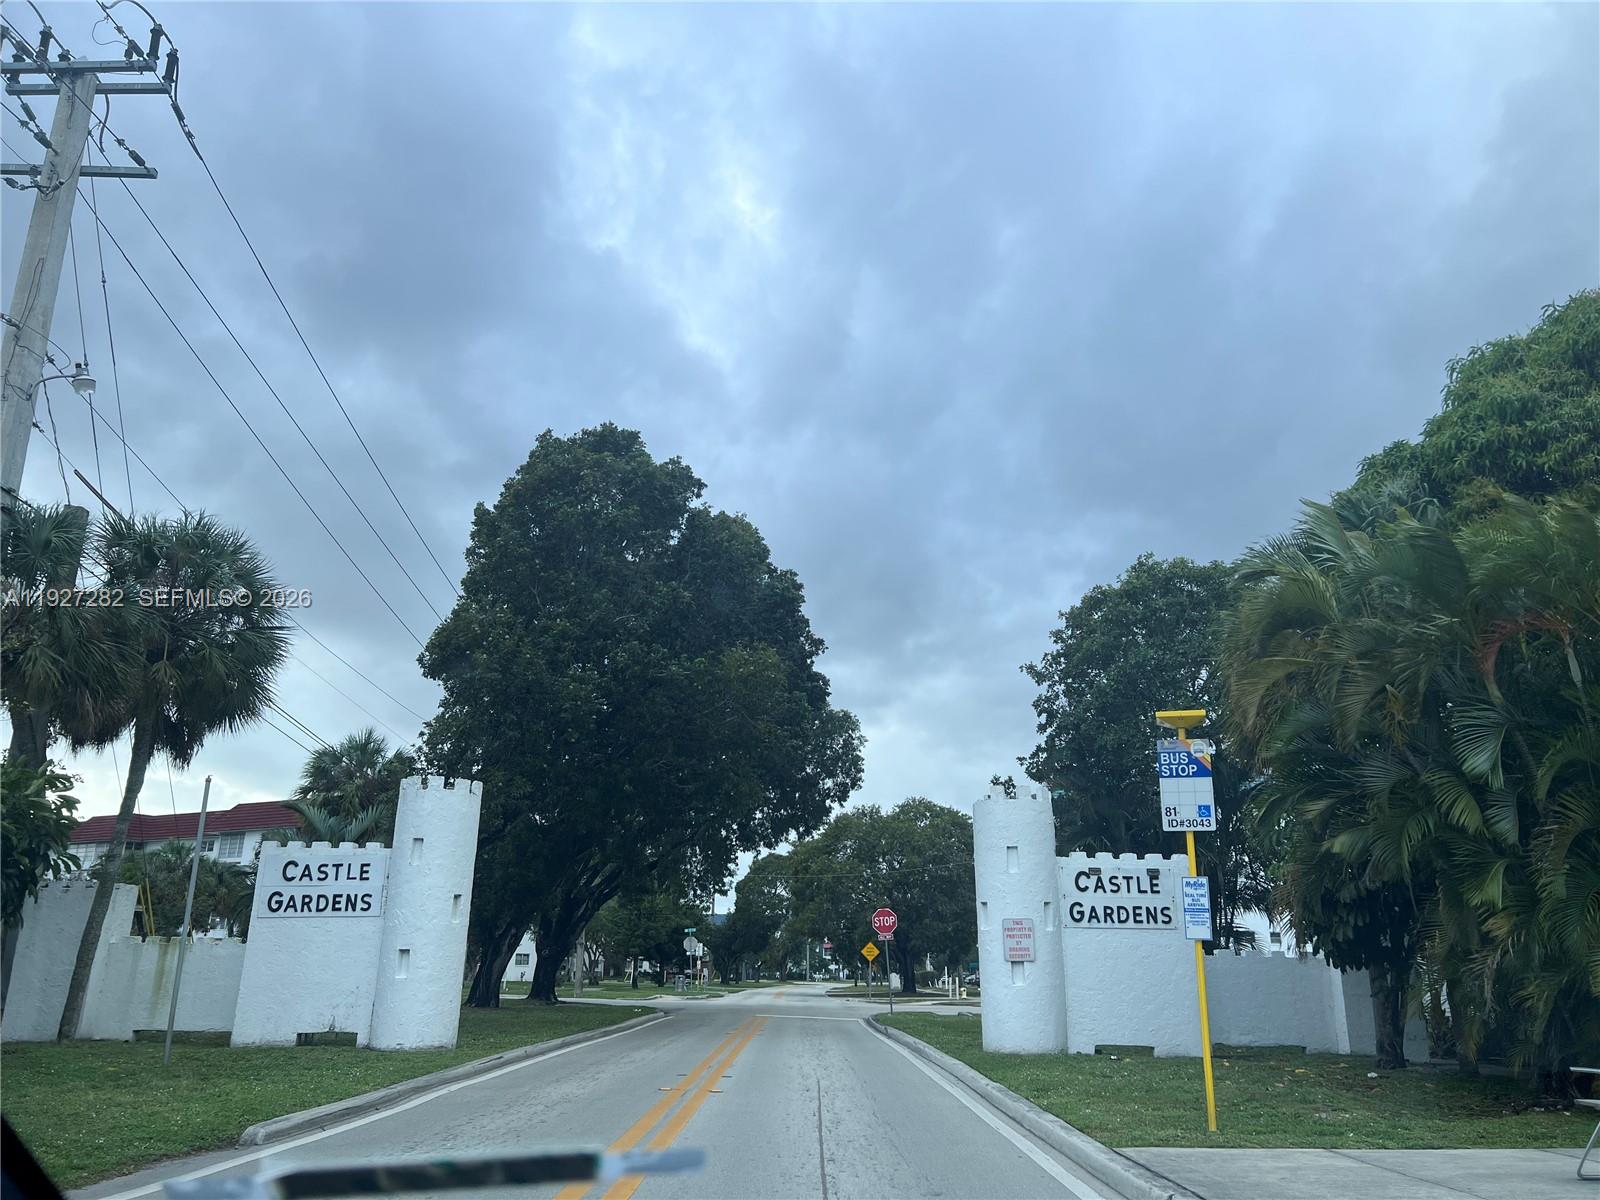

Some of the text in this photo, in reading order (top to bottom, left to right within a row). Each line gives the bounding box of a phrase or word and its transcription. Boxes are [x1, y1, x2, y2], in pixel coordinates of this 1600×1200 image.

[1161, 752, 1189, 764] BUS
[1161, 764, 1197, 777] STOP
[1165, 806, 1177, 817] 81
[1168, 819, 1212, 828] ID#3043
[282, 860, 371, 882] CASTLE
[1075, 870, 1161, 894] CASTLE
[268, 891, 373, 913] GARDENS
[1069, 902, 1172, 924] GARDENS
[874, 916, 895, 927] STOP
